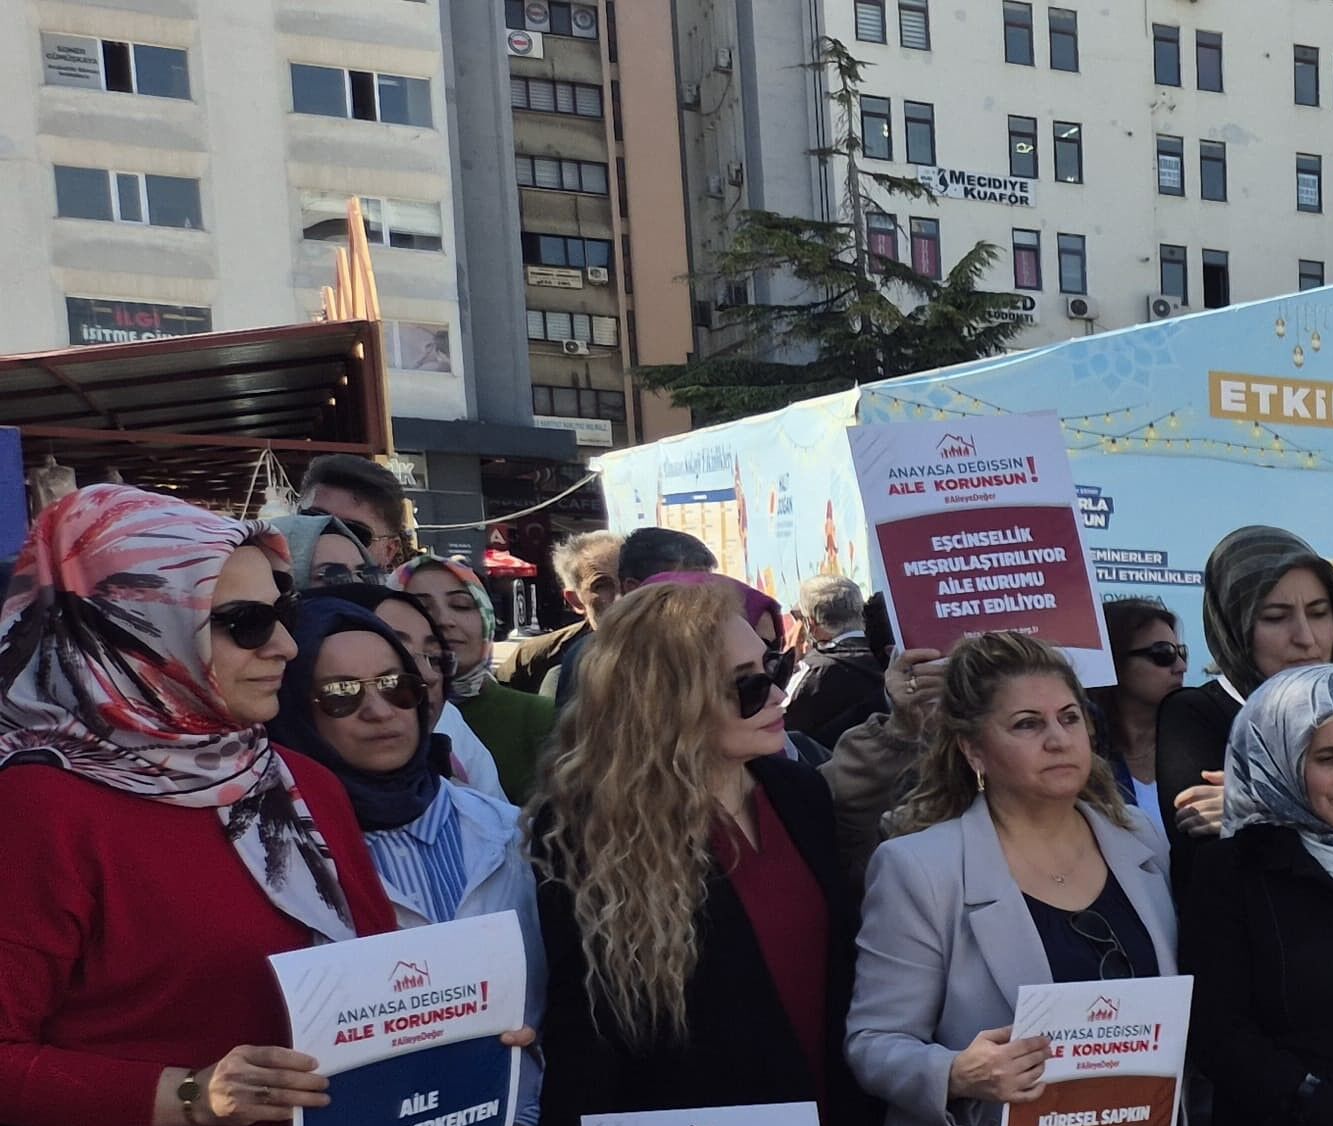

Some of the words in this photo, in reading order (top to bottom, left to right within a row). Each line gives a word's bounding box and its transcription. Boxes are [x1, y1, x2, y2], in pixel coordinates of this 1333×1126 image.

[888, 463, 954, 479] ANAYASA
[888, 481, 926, 496] AİLE
[930, 525, 1034, 554] EŞCİNSELLİK
[904, 547, 1068, 577] MEŞRULAŞTIRILIYOR
[1091, 548, 1163, 565] EMİNERLER
[938, 576, 976, 597] AİLE
[976, 570, 1045, 593] KURUMU
[1096, 566, 1116, 580] TLİ
[1118, 568, 1202, 585] ETKİNLİKLER
[984, 592, 1057, 615] EDİLİYOR
[337, 999, 407, 1025] ANAYASA
[334, 1024, 375, 1046] AİLE
[398, 1090, 440, 1119] AİLE
[1100, 1105, 1151, 1126] SAPKIN
